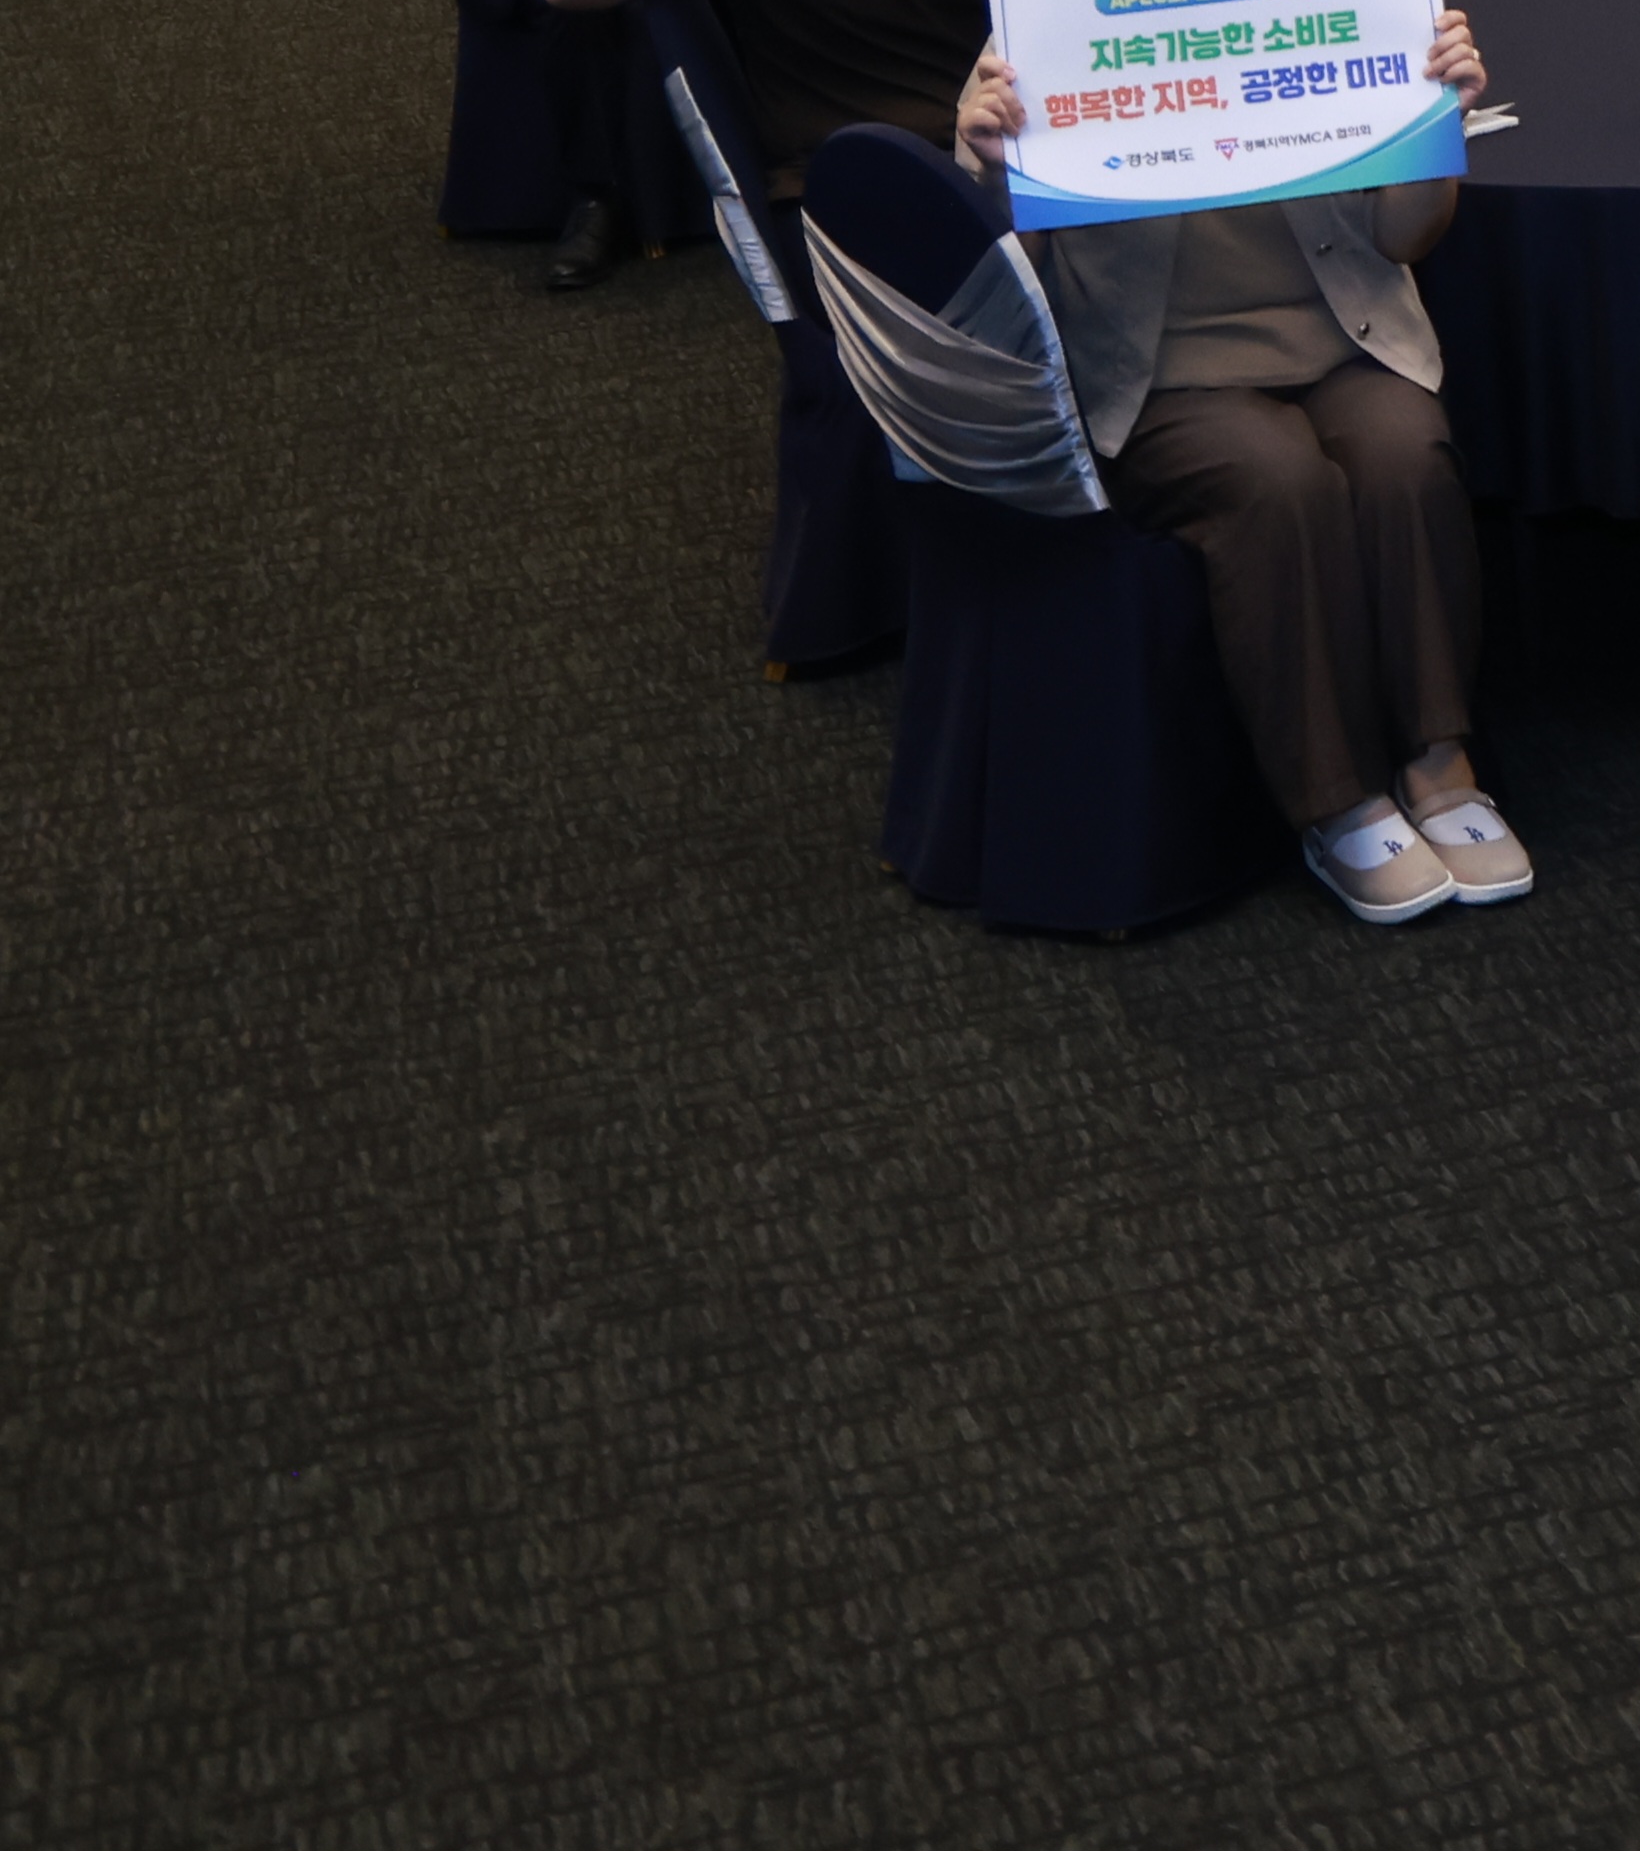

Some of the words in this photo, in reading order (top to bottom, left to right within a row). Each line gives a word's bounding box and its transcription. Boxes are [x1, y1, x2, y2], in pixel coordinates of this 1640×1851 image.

[1089, 22, 1255, 71] 지속가능한
[1263, 9, 1360, 51] 소비로
[1043, 85, 1146, 127] 행복한
[1152, 75, 1228, 114] 지역,
[1241, 61, 1338, 103] 공정한
[1345, 52, 1409, 90] 미래
